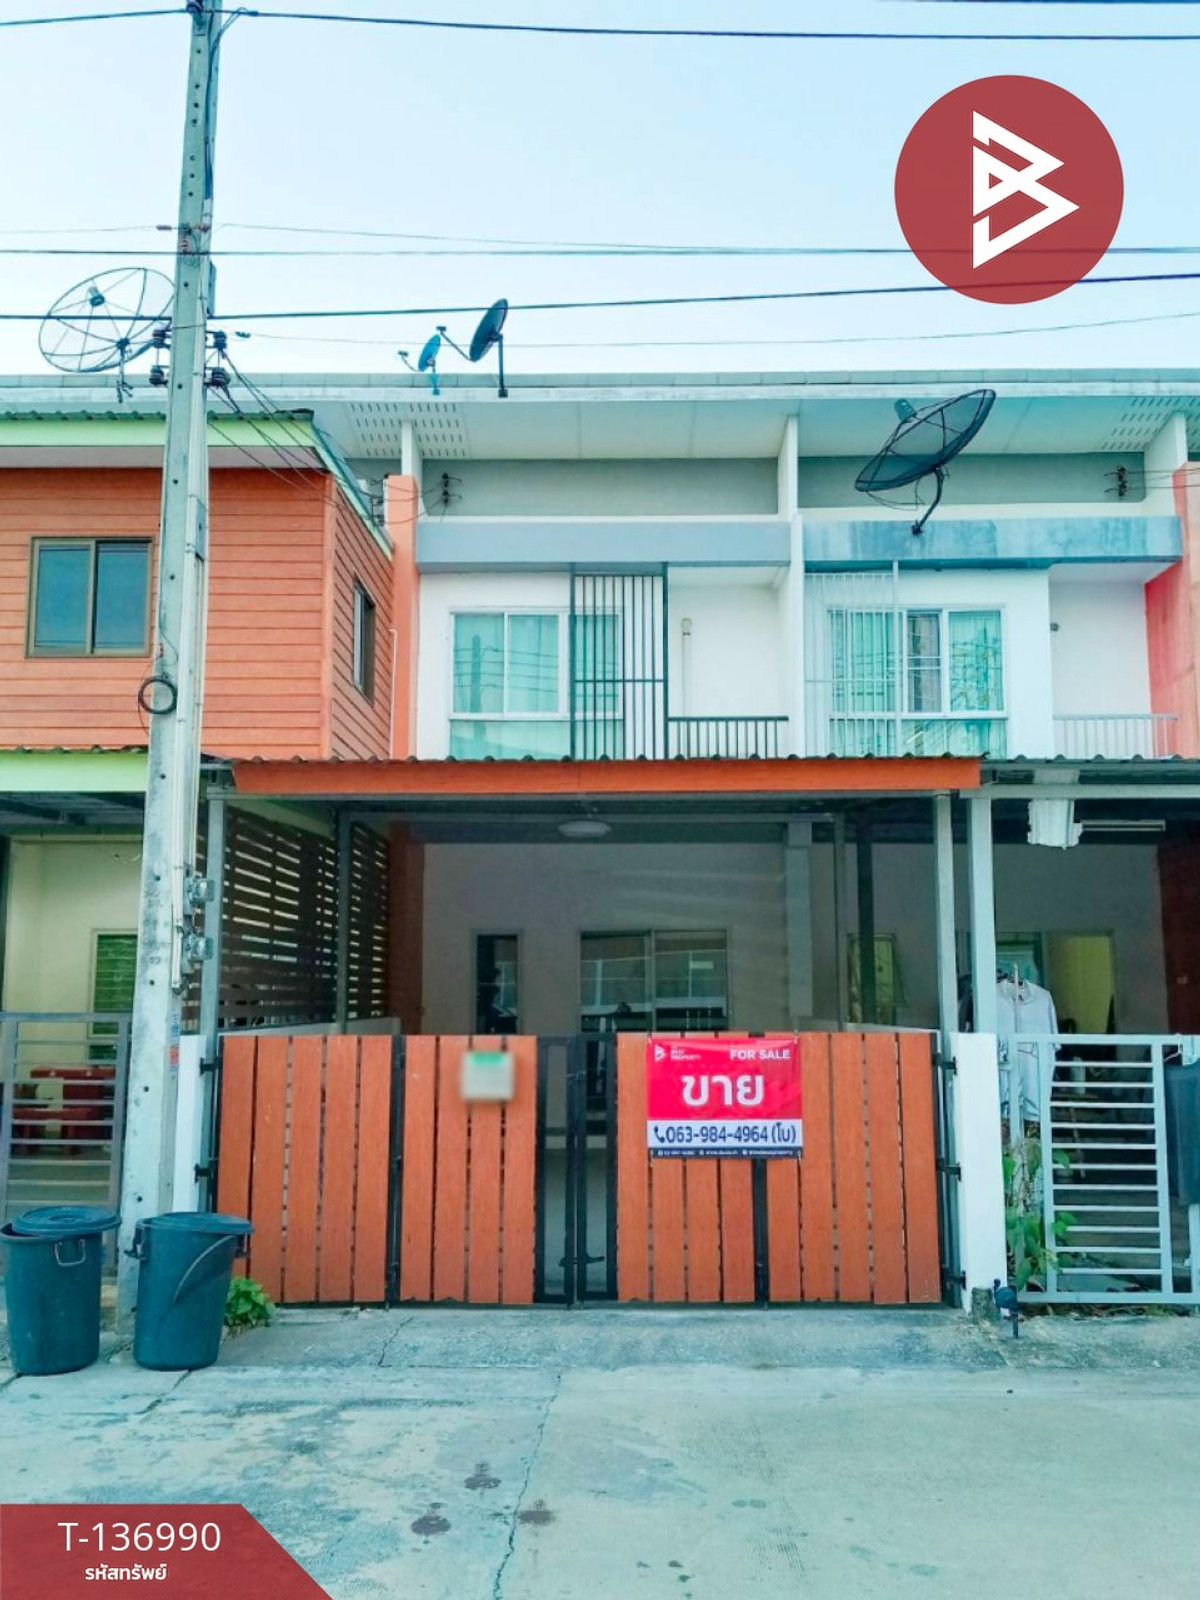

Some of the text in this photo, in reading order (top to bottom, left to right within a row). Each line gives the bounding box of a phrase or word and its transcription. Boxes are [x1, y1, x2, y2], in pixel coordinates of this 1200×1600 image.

[730, 1049, 791, 1060] FOR SALE
[681, 1074, 765, 1107] ขาย
[665, 1126, 769, 1143] 063-984-4964
